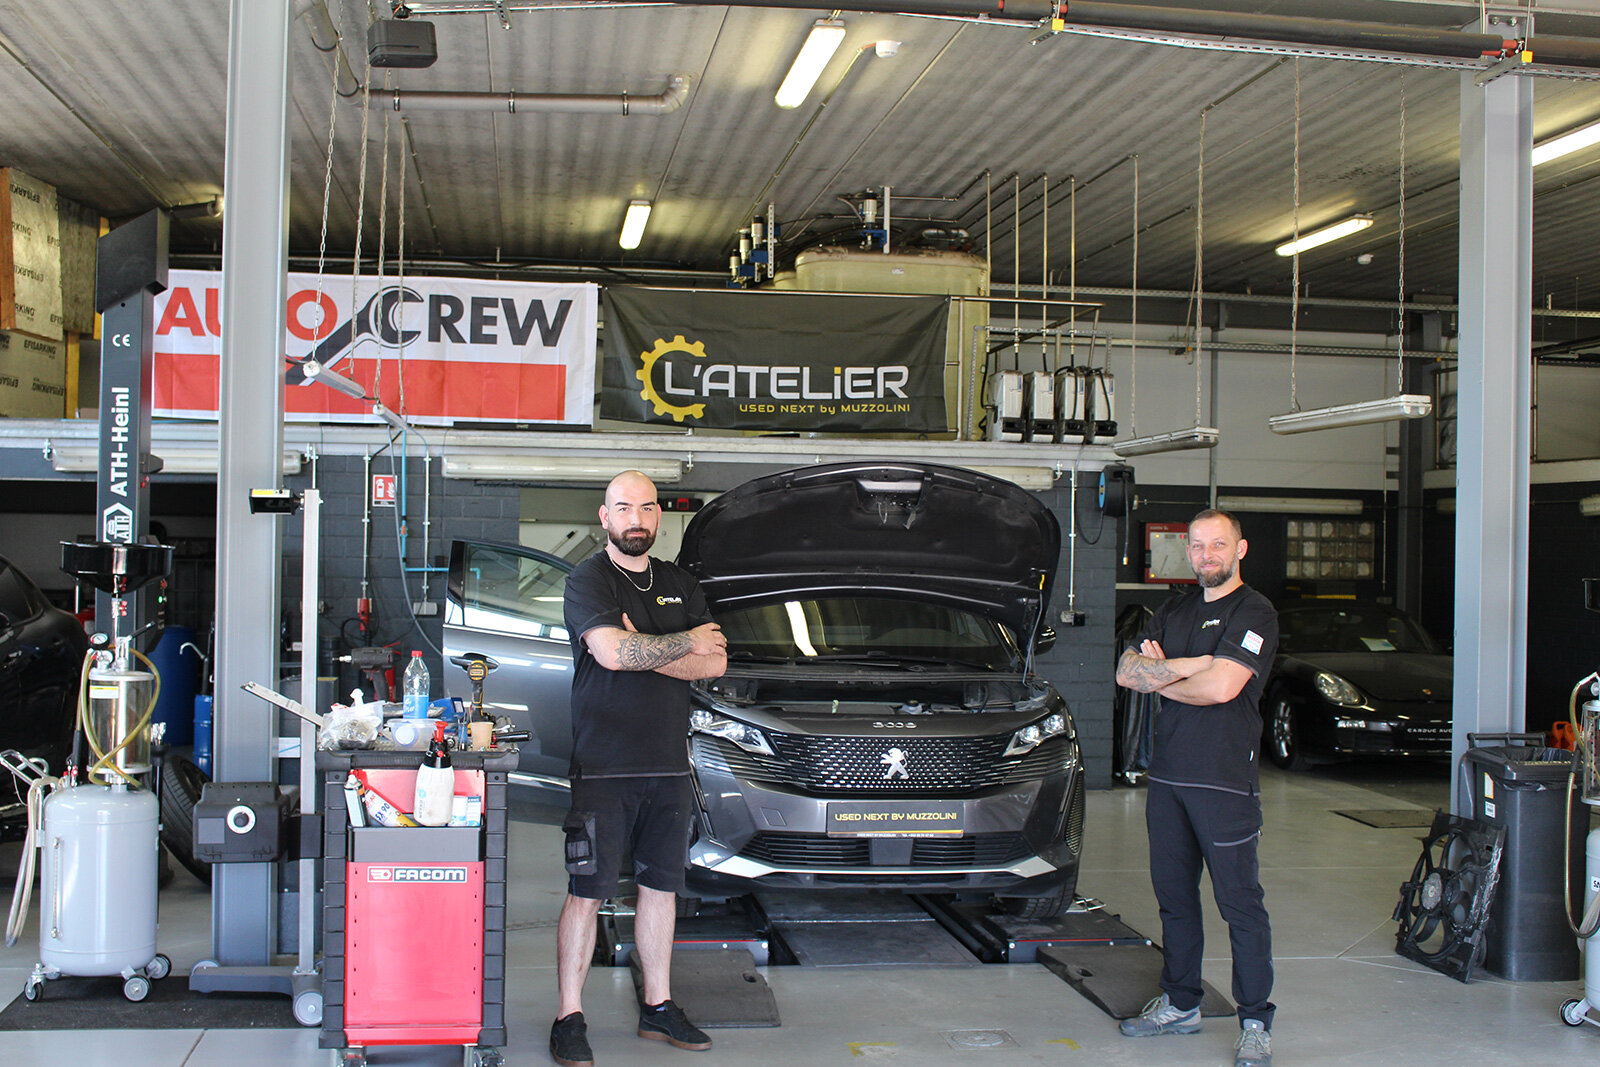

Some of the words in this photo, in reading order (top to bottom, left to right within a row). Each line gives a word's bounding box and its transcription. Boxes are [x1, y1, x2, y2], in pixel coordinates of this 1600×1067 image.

[376, 285, 573, 348] CREW
[112, 334, 131, 347] CE
[739, 404, 775, 413] USED
[780, 404, 815, 414] NEXT
[820, 404, 836, 415] by
[841, 403, 911, 413] MUZZOLINI
[110, 387, 130, 497] ATH-Heinl
[835, 813, 861, 821] USED
[864, 813, 889, 821] NEXT
[891, 813, 905, 821] BY
[906, 812, 957, 821] MUZZOLINI
[395, 869, 465, 881] FACOM
